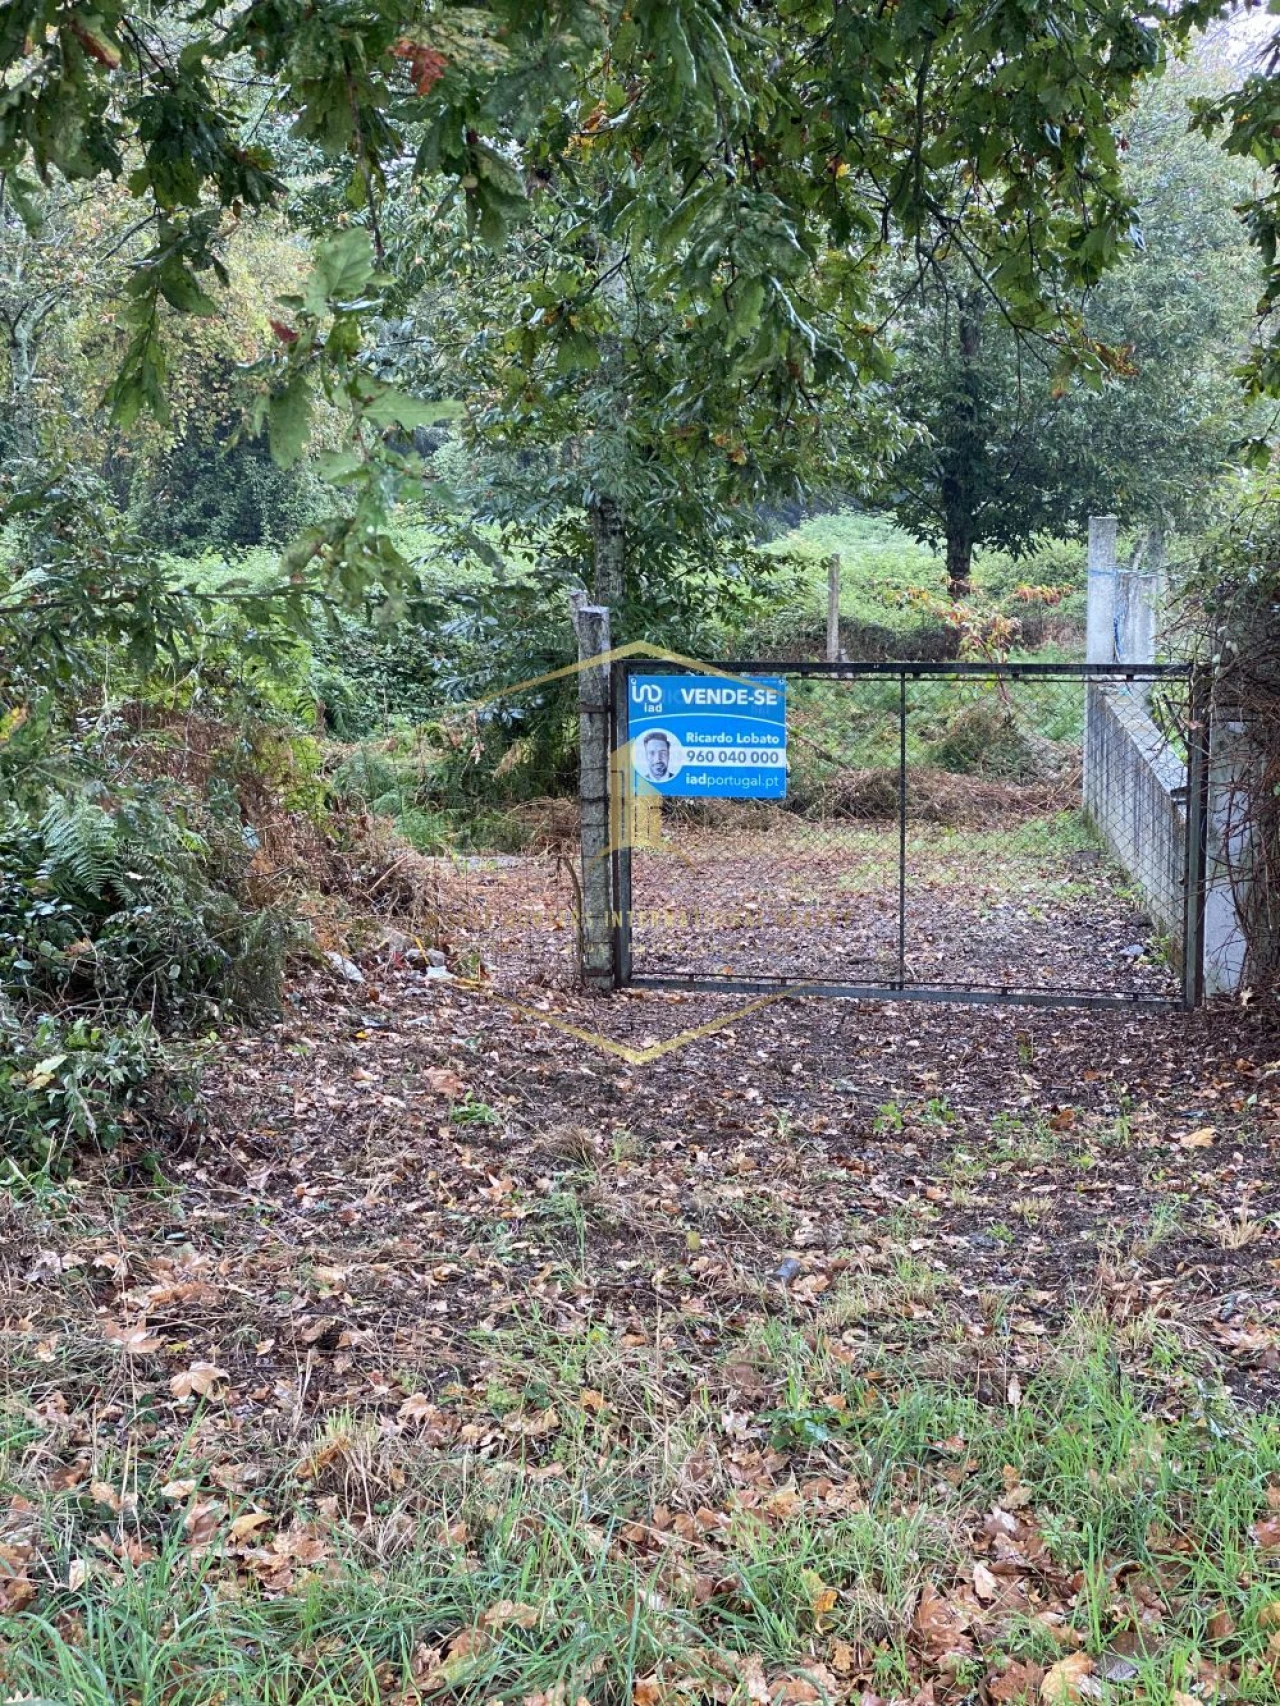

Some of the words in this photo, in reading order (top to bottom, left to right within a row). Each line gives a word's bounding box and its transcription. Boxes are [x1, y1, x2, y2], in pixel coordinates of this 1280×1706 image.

[681, 688, 778, 705] VENDE-SE
[643, 703, 663, 713] iad
[685, 732, 733, 744] Ricardo
[736, 732, 780, 744] Lobato
[686, 750, 714, 763] 960
[718, 750, 747, 763] 040
[750, 751, 779, 764] 000
[685, 773, 779, 789] iadportugal.pt
